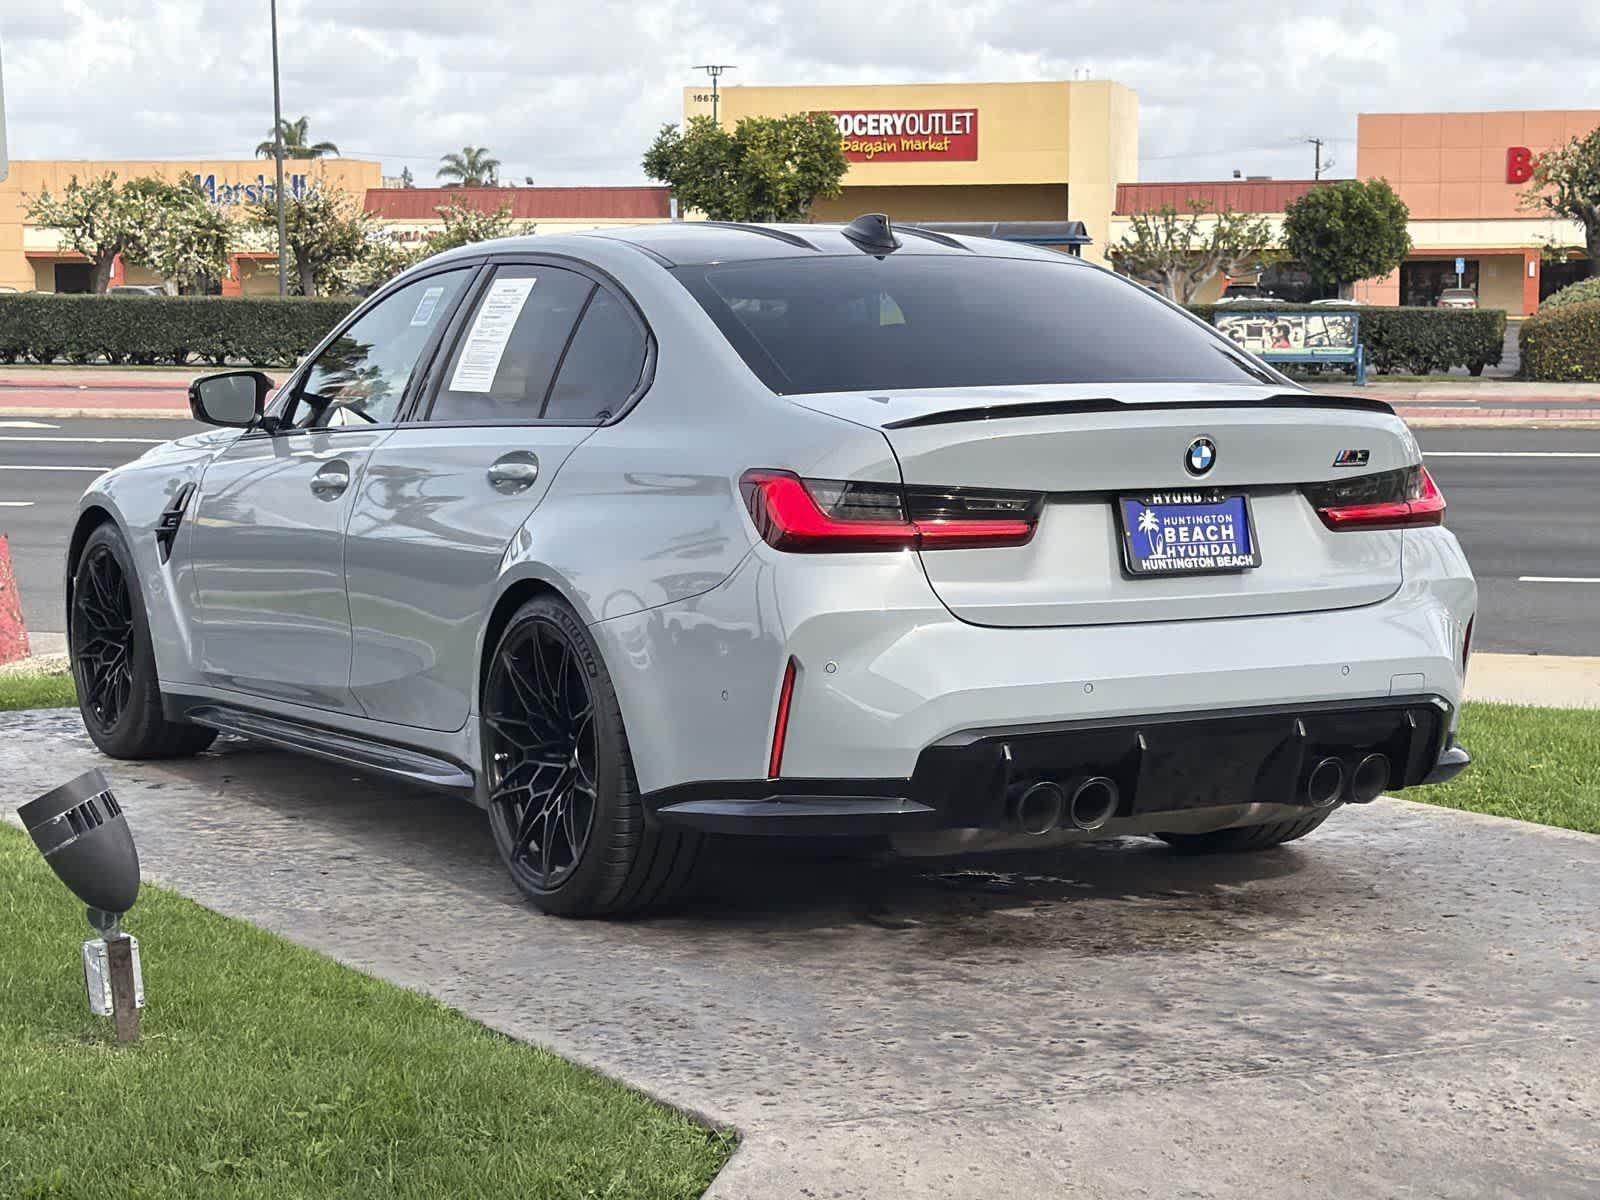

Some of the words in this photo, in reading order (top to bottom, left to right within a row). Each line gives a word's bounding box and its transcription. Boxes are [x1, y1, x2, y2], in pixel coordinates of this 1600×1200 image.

[828, 112, 974, 136] OCERYOUTLET
[193, 174, 319, 204] Marshll
[1163, 514, 1233, 526] HUNTINGTON
[1164, 524, 1235, 543] BEACH
[1166, 543, 1237, 558] HYUNDAI
[1142, 557, 1215, 570] HUNTINGTON
[1216, 554, 1254, 567] BEACH
